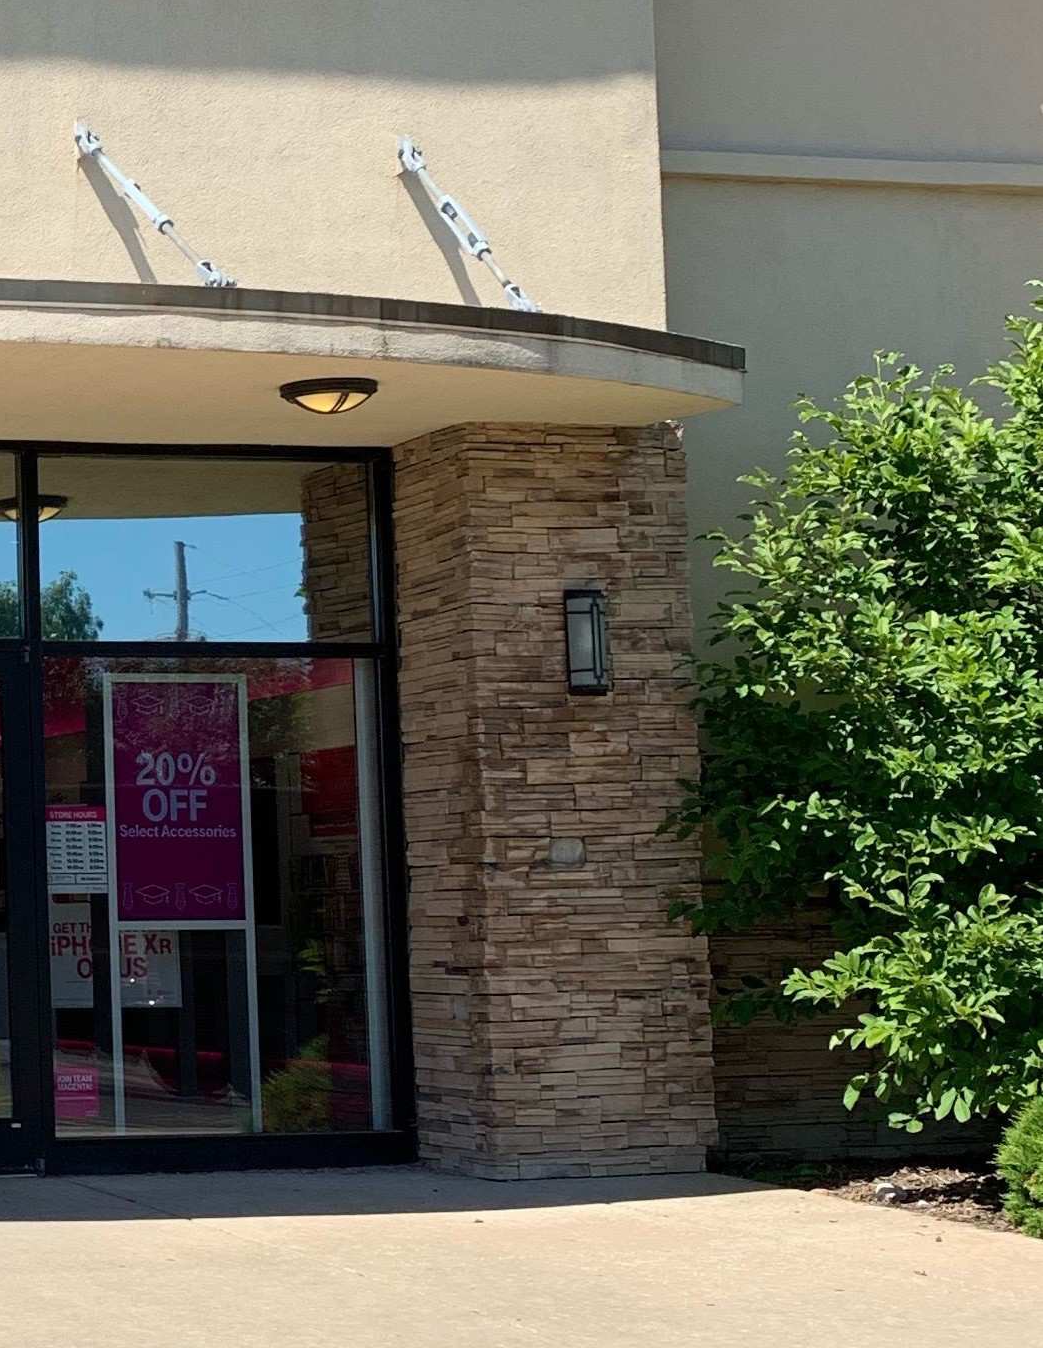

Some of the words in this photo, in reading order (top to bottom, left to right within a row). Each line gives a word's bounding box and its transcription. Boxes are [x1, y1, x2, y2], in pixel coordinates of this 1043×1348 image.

[135, 751, 216, 786] 20%
[142, 788, 208, 822] OFF
[119, 824, 159, 838] Select
[161, 824, 237, 838] Accessories
[52, 922, 76, 935] GET
